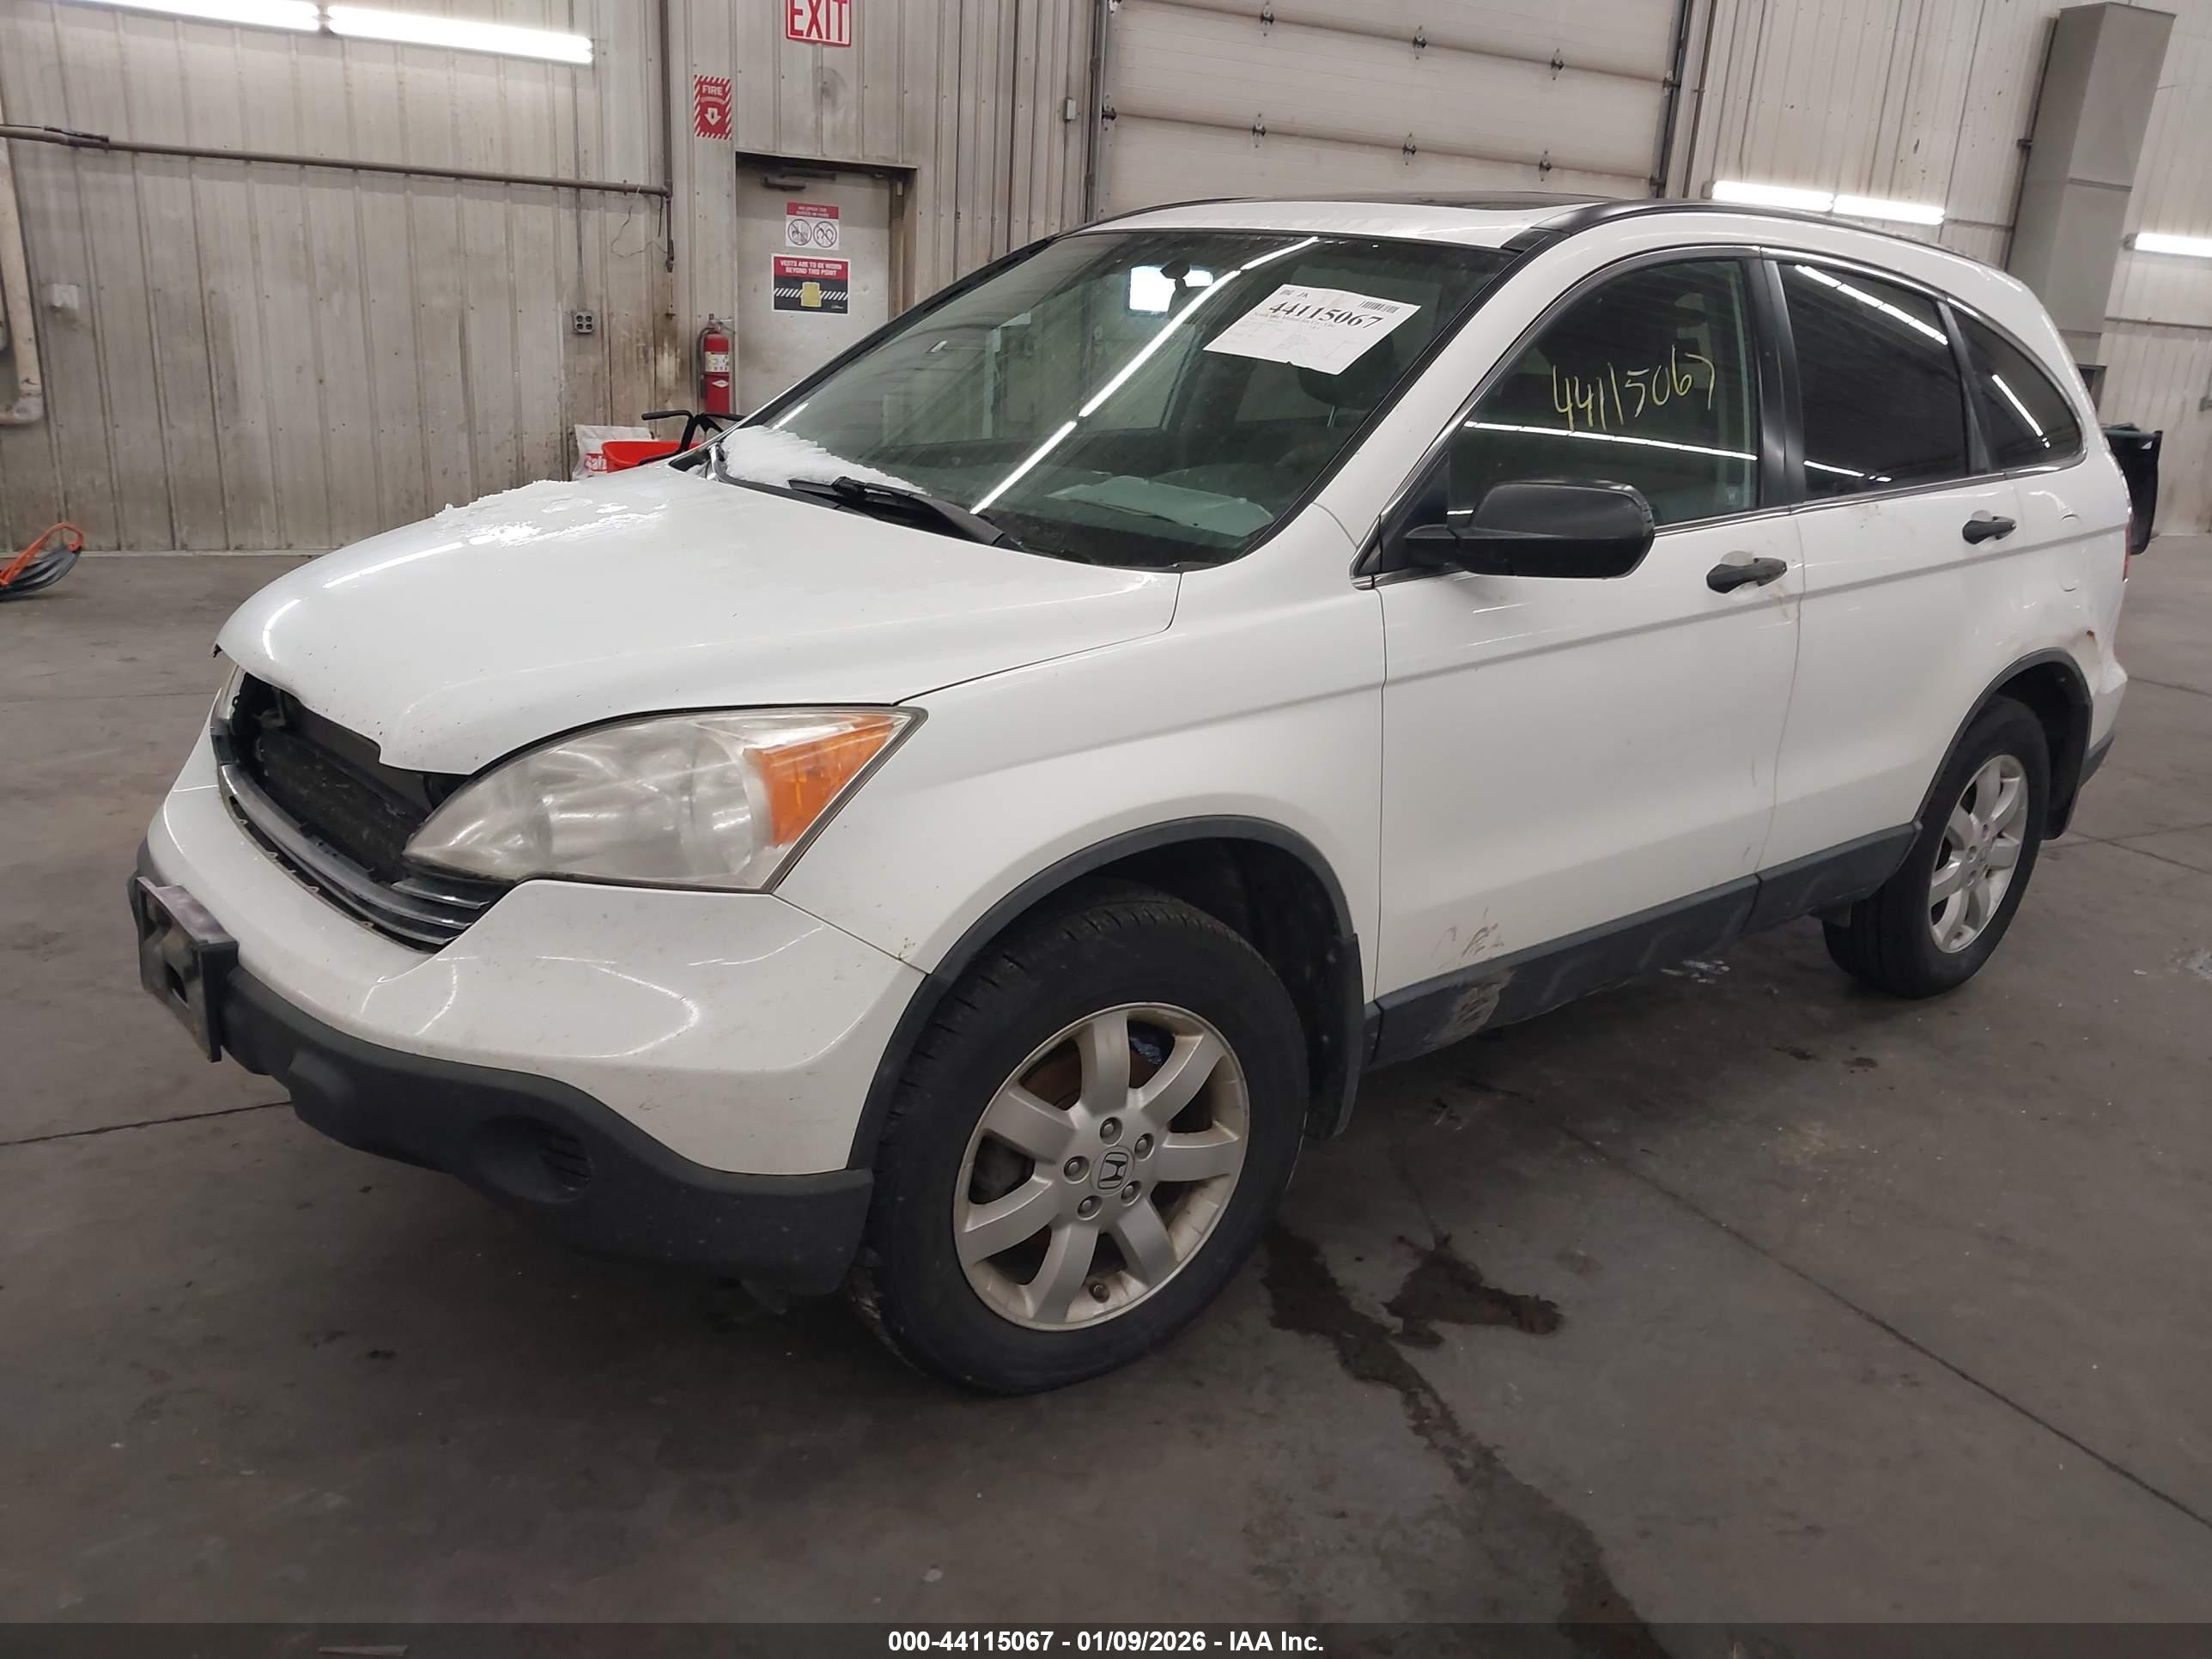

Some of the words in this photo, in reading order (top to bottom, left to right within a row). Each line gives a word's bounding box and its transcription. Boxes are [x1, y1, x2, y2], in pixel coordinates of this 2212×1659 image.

[790, 0, 848, 41] EXIT
[702, 84, 723, 96] FIRE
[1268, 301, 1384, 329] 44115067
[1552, 343, 1716, 431] 44115067
